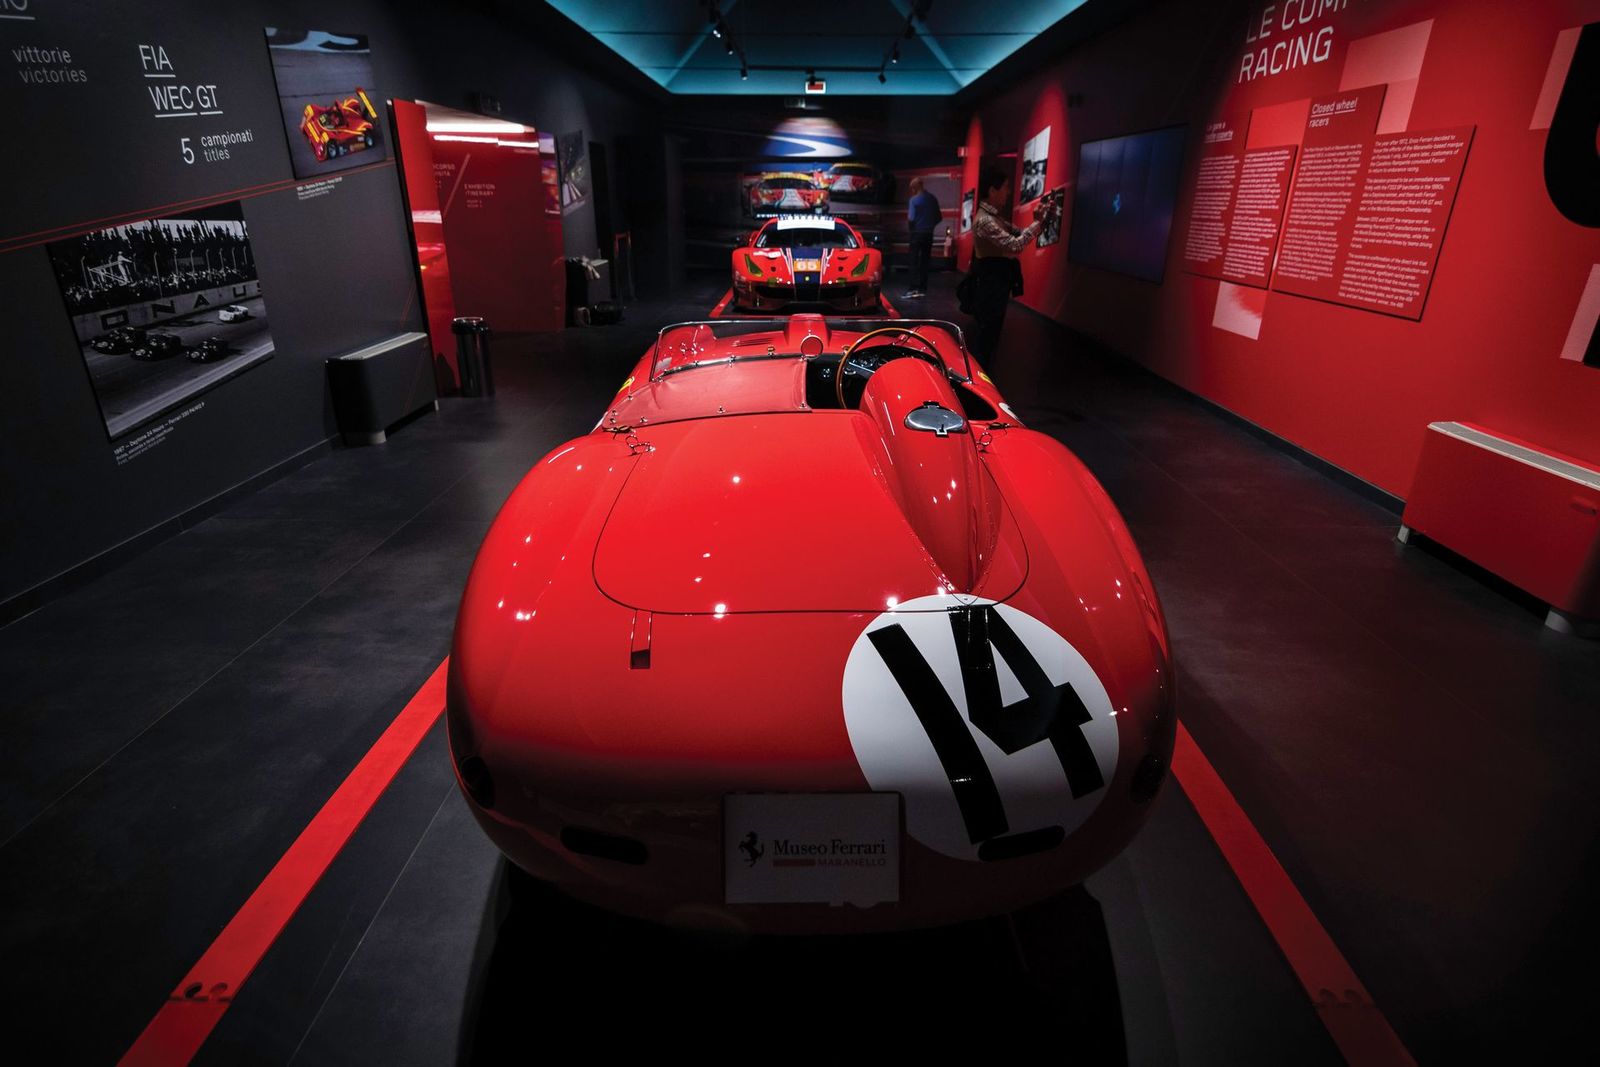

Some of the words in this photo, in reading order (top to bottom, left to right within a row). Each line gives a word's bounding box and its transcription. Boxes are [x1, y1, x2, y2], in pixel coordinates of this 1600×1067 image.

[1246, 6, 1276, 43] LE
[12, 46, 72, 64] vittorie
[139, 45, 173, 71] FIA
[1239, 26, 1334, 83] RACING
[18, 66, 88, 83] victories
[148, 87, 194, 111] WEC
[196, 85, 218, 109] GT
[1312, 101, 1335, 114] Closed
[1336, 97, 1358, 110] wheel
[1309, 118, 1330, 128] racers
[181, 138, 195, 164] 5
[201, 129, 253, 148] campionati
[204, 147, 231, 163] titles
[866, 604, 1105, 845] 14
[773, 839, 827, 856] Museo
[831, 838, 886, 855] Ferrari
[817, 858, 886, 867] MARANELLO
